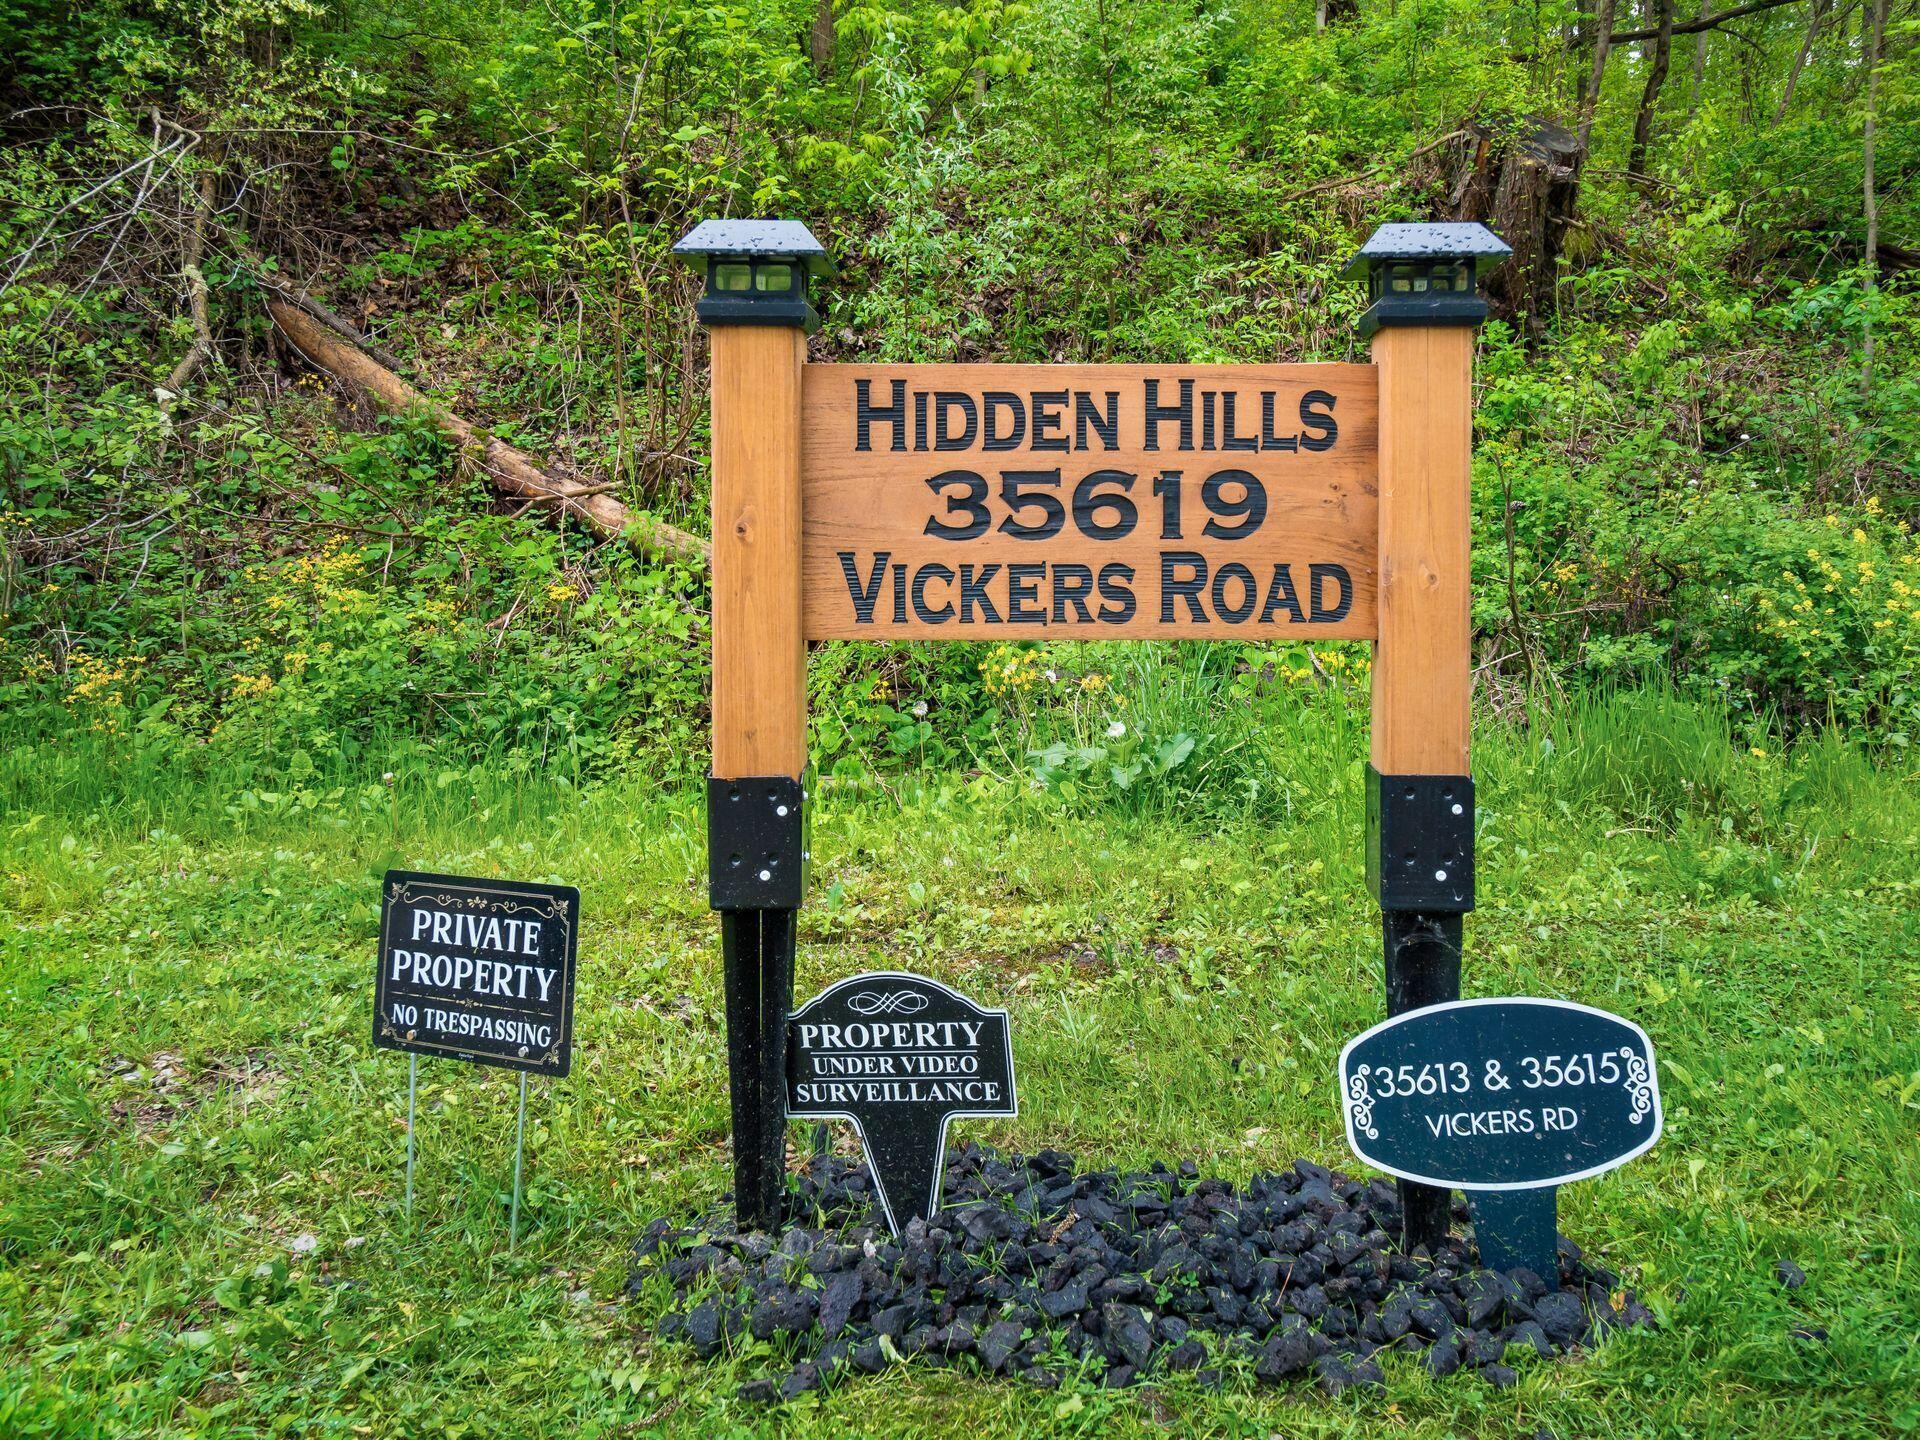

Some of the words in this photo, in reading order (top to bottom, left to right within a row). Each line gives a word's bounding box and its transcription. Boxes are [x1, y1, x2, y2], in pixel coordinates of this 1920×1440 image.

[854, 378, 1120, 455] HIDDEN
[1143, 378, 1339, 455] HILLS
[923, 467, 1268, 541] 35619
[836, 551, 1138, 627] VICKERS
[1158, 550, 1353, 625] ROAD
[411, 908, 541, 956] PRIVATE
[391, 949, 557, 1002] PROPERTY
[392, 1003, 418, 1026] NO
[424, 1008, 552, 1048] TRESPASSING
[800, 1021, 984, 1049] PROPERTY
[812, 1056, 896, 1075] UNDER
[900, 1055, 979, 1074] VIDEO
[1375, 1061, 1470, 1098] 35613
[1483, 1059, 1512, 1091] &
[1521, 1051, 1620, 1089] 35615
[796, 1082, 1001, 1103] SURVEILLANCE
[1425, 1108, 1535, 1138] VICKERS
[1542, 1106, 1578, 1131] RD
